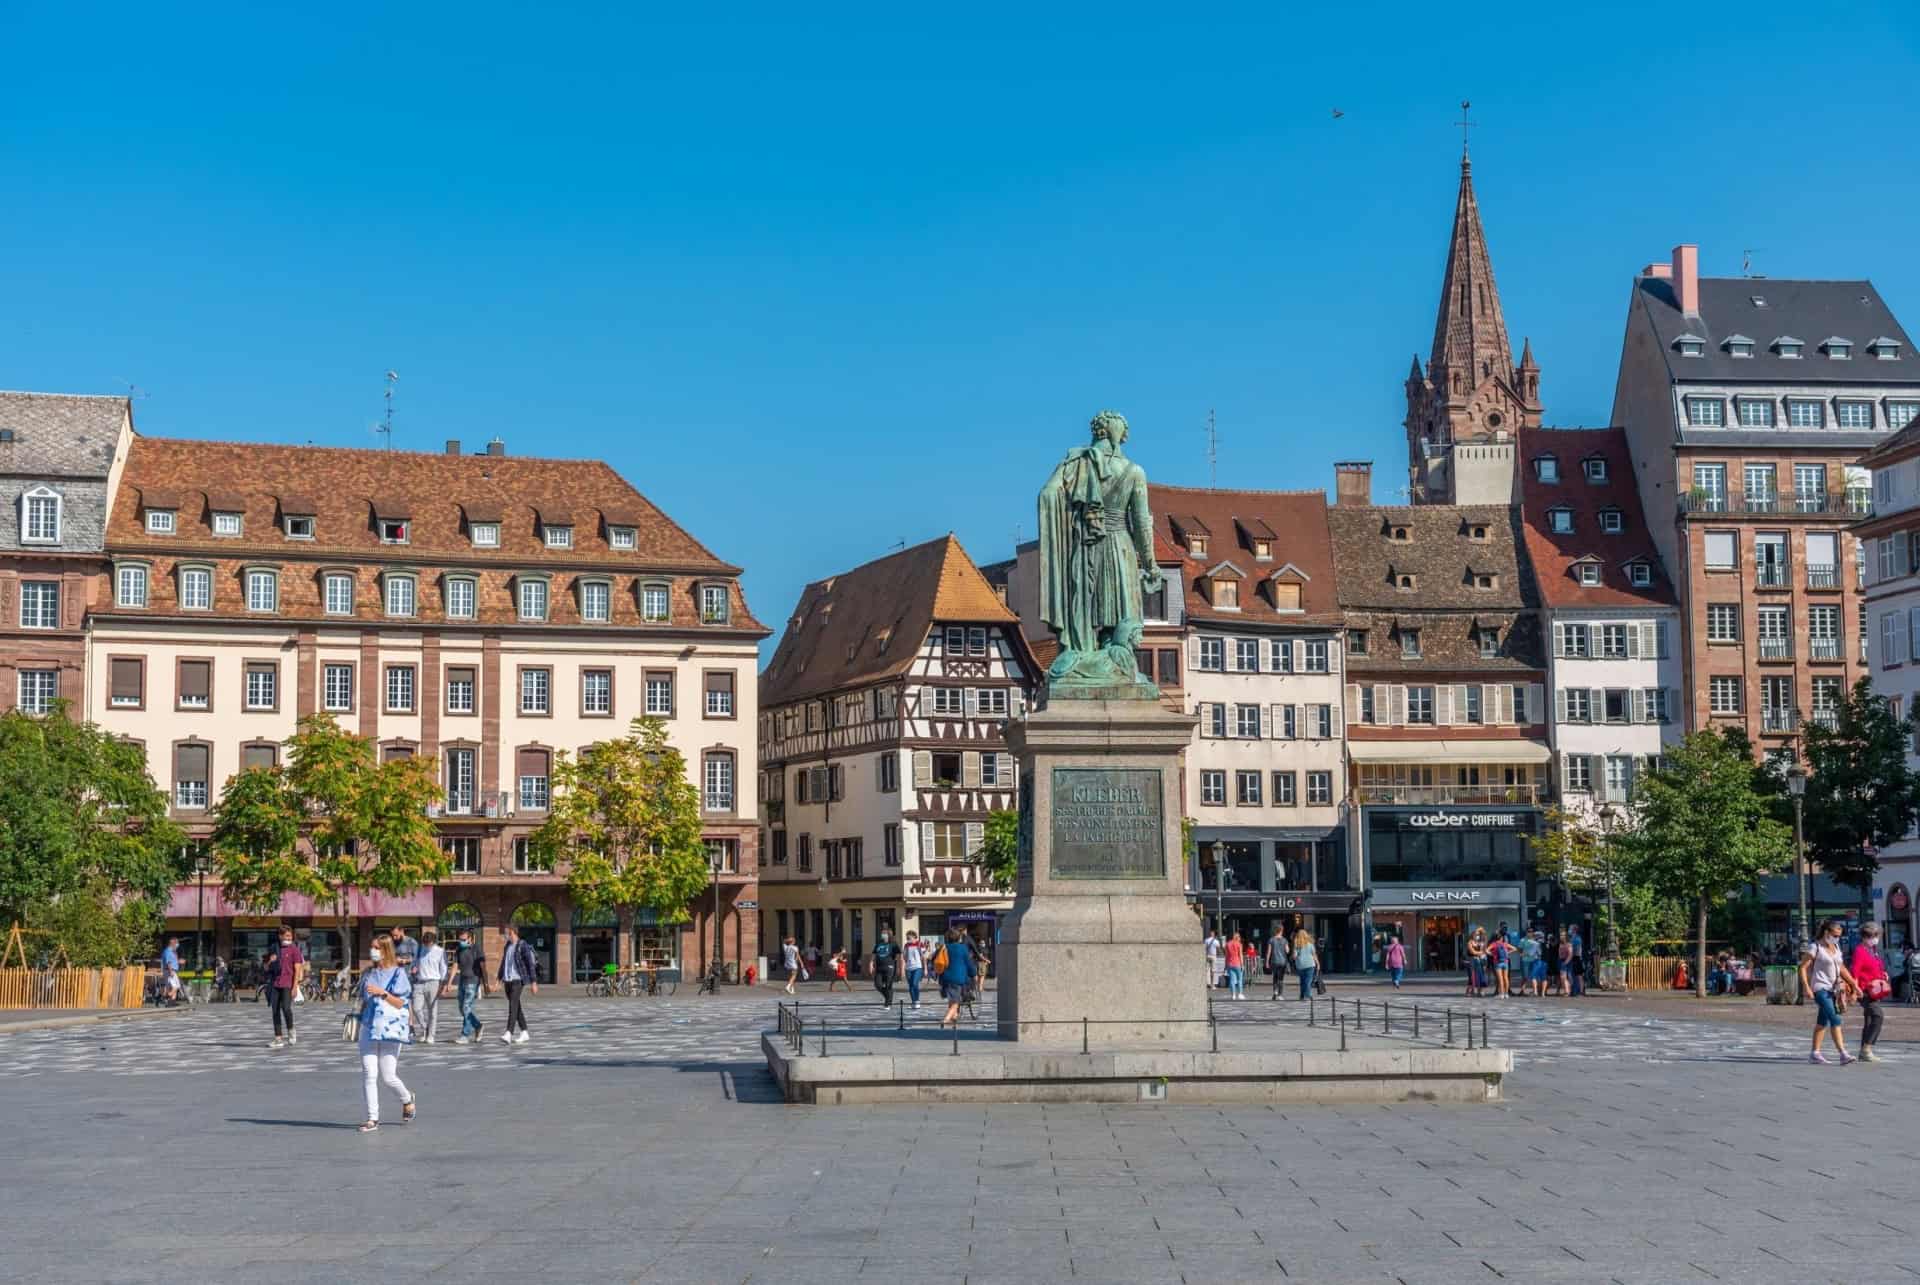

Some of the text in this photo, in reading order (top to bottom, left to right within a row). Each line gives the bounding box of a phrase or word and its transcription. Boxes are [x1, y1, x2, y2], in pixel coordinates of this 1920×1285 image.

[1410, 811, 1515, 826] weber COIFFURE
[1412, 891, 1481, 900] NAF NAF
